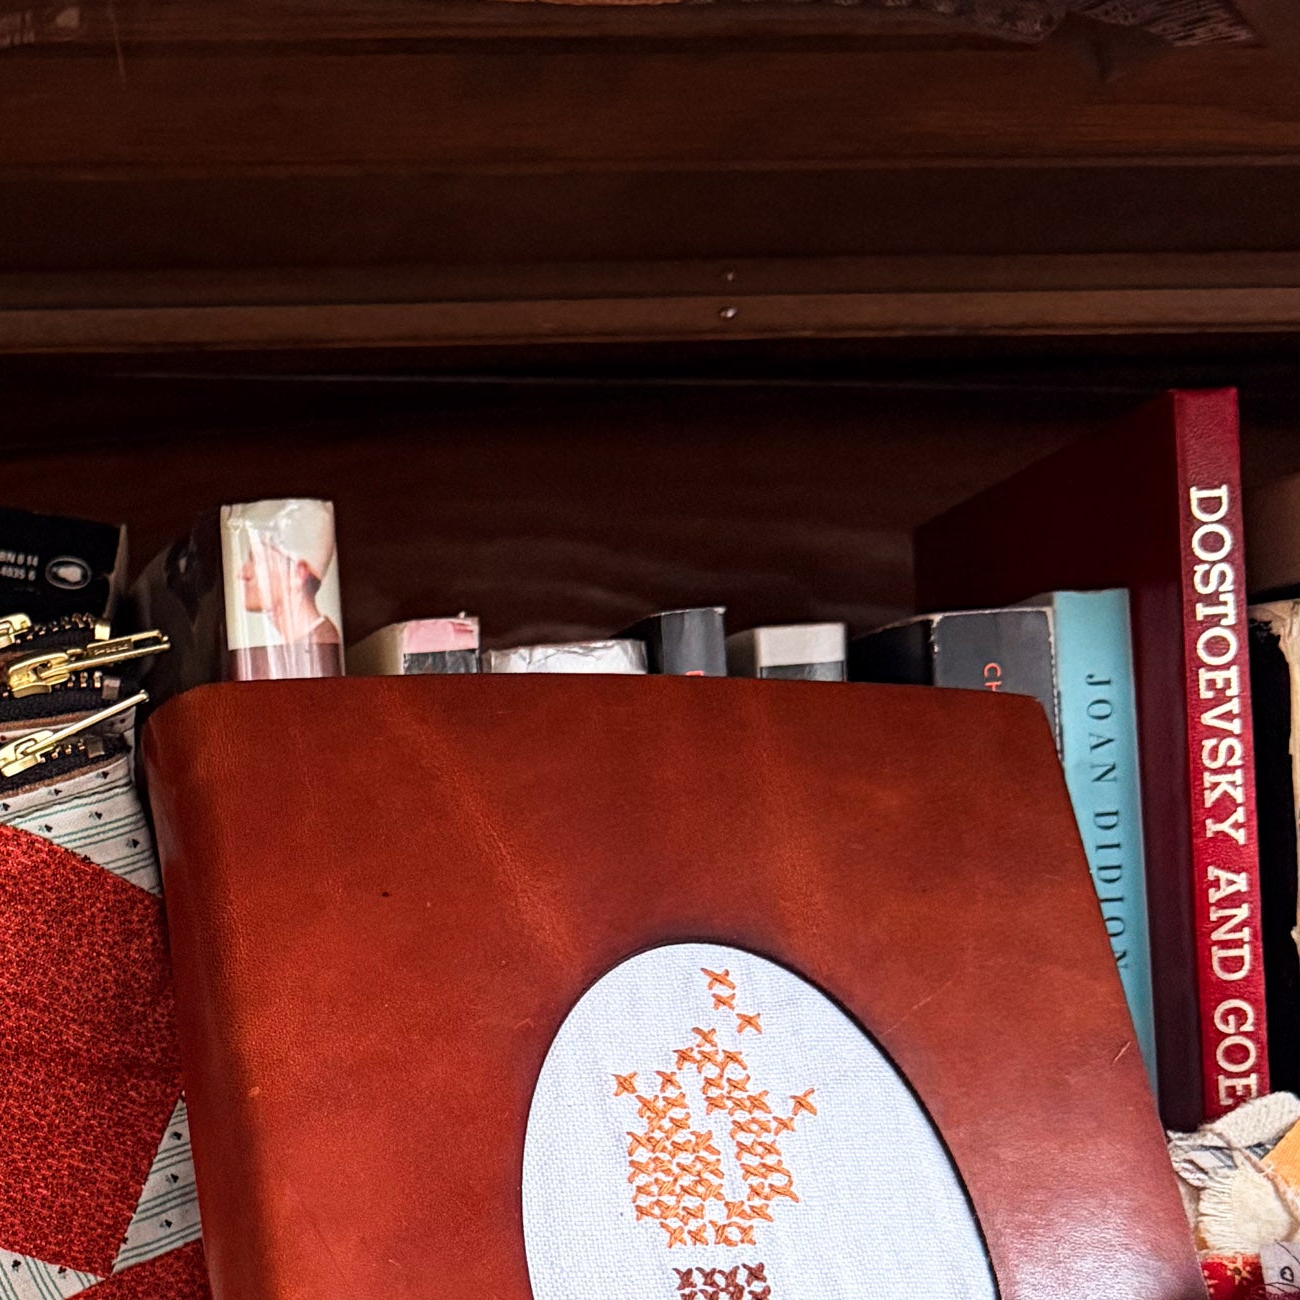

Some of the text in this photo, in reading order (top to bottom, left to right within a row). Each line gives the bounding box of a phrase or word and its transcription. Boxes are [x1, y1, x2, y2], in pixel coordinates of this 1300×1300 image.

[1189, 484, 1247, 845] DOSTOEVSKY
[1085, 673, 1118, 783] JOAN
[1207, 866, 1252, 982] AND
